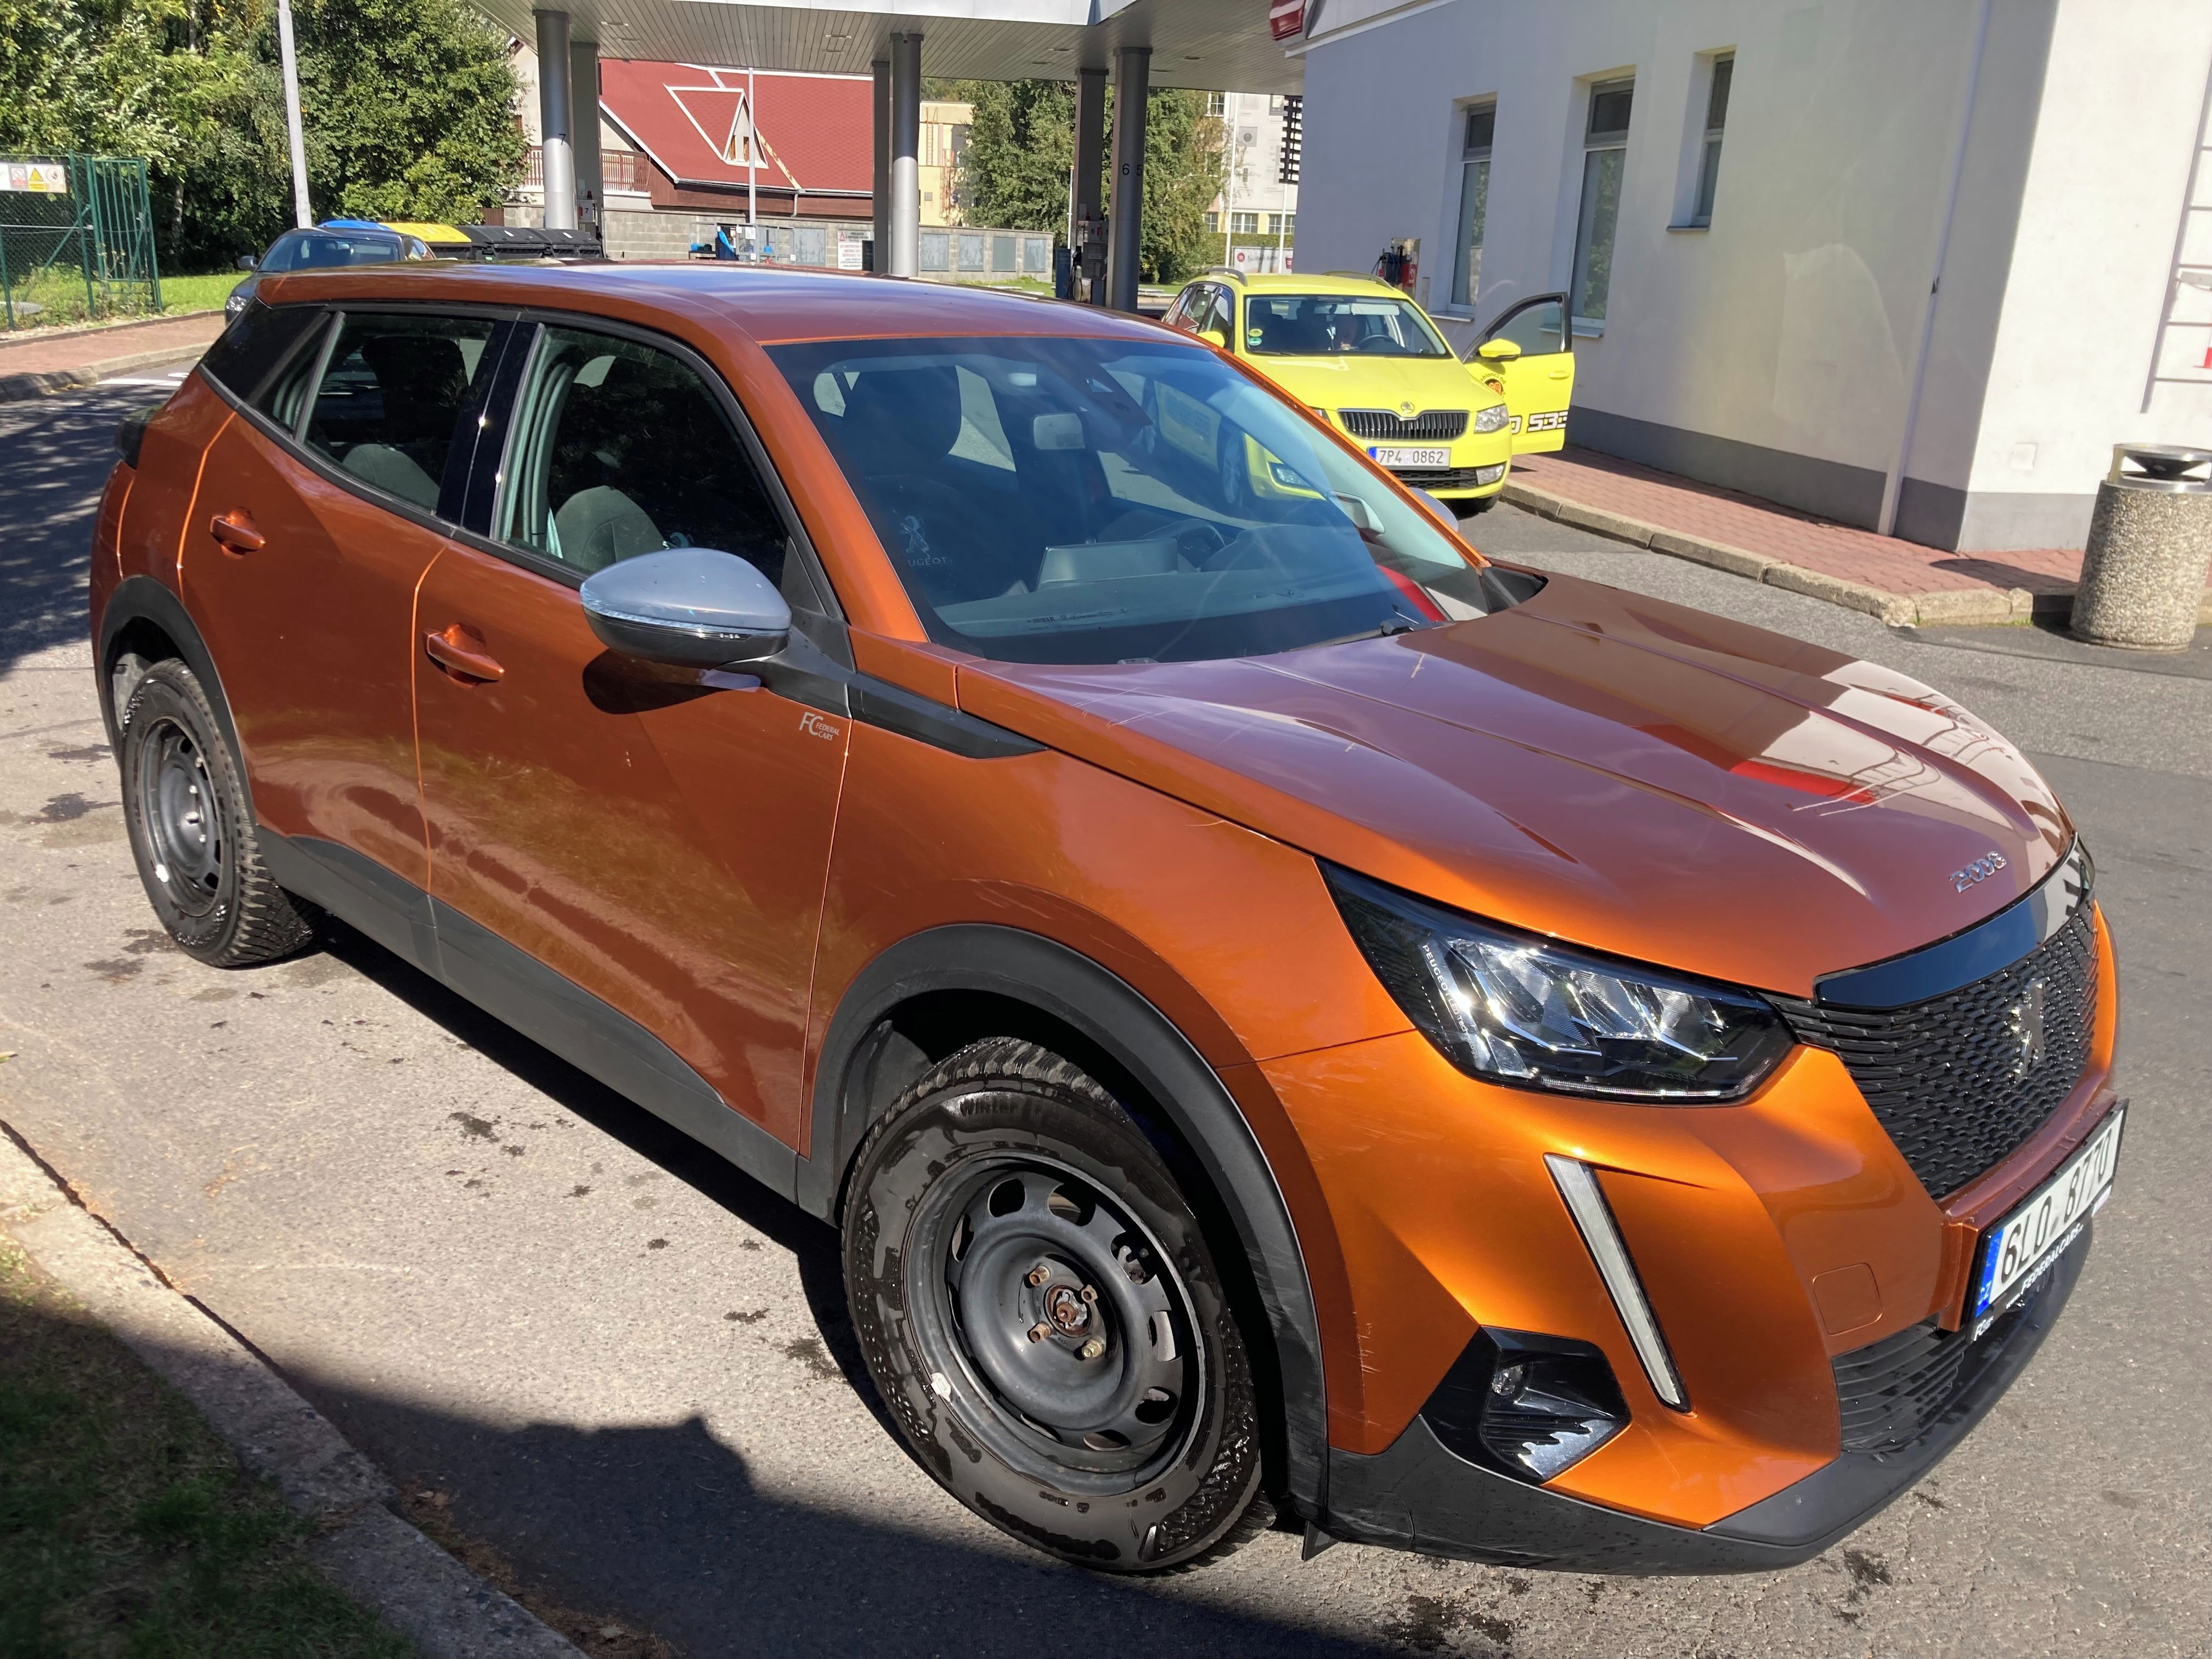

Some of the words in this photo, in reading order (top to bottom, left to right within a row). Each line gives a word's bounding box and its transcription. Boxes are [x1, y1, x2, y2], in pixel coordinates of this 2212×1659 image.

[558, 133, 566, 145] 7
[1122, 163, 1130, 175] 6
[1379, 450, 1402, 463] 7P4
[1413, 450, 1443, 464] 0862
[908, 556, 947, 567] UGEOT
[799, 712, 824, 736] FC
[815, 722, 840, 736] FEDERAL
[818, 731, 834, 741] CARS
[1948, 851, 2007, 893] 2008
[1422, 944, 1452, 996] PEUGEOT
[1448, 997, 1460, 1015] LED
[1457, 1015, 1479, 1059] Technology
[2001, 1195, 2052, 1284] 6L0
[2064, 1127, 2112, 1223] 8770
